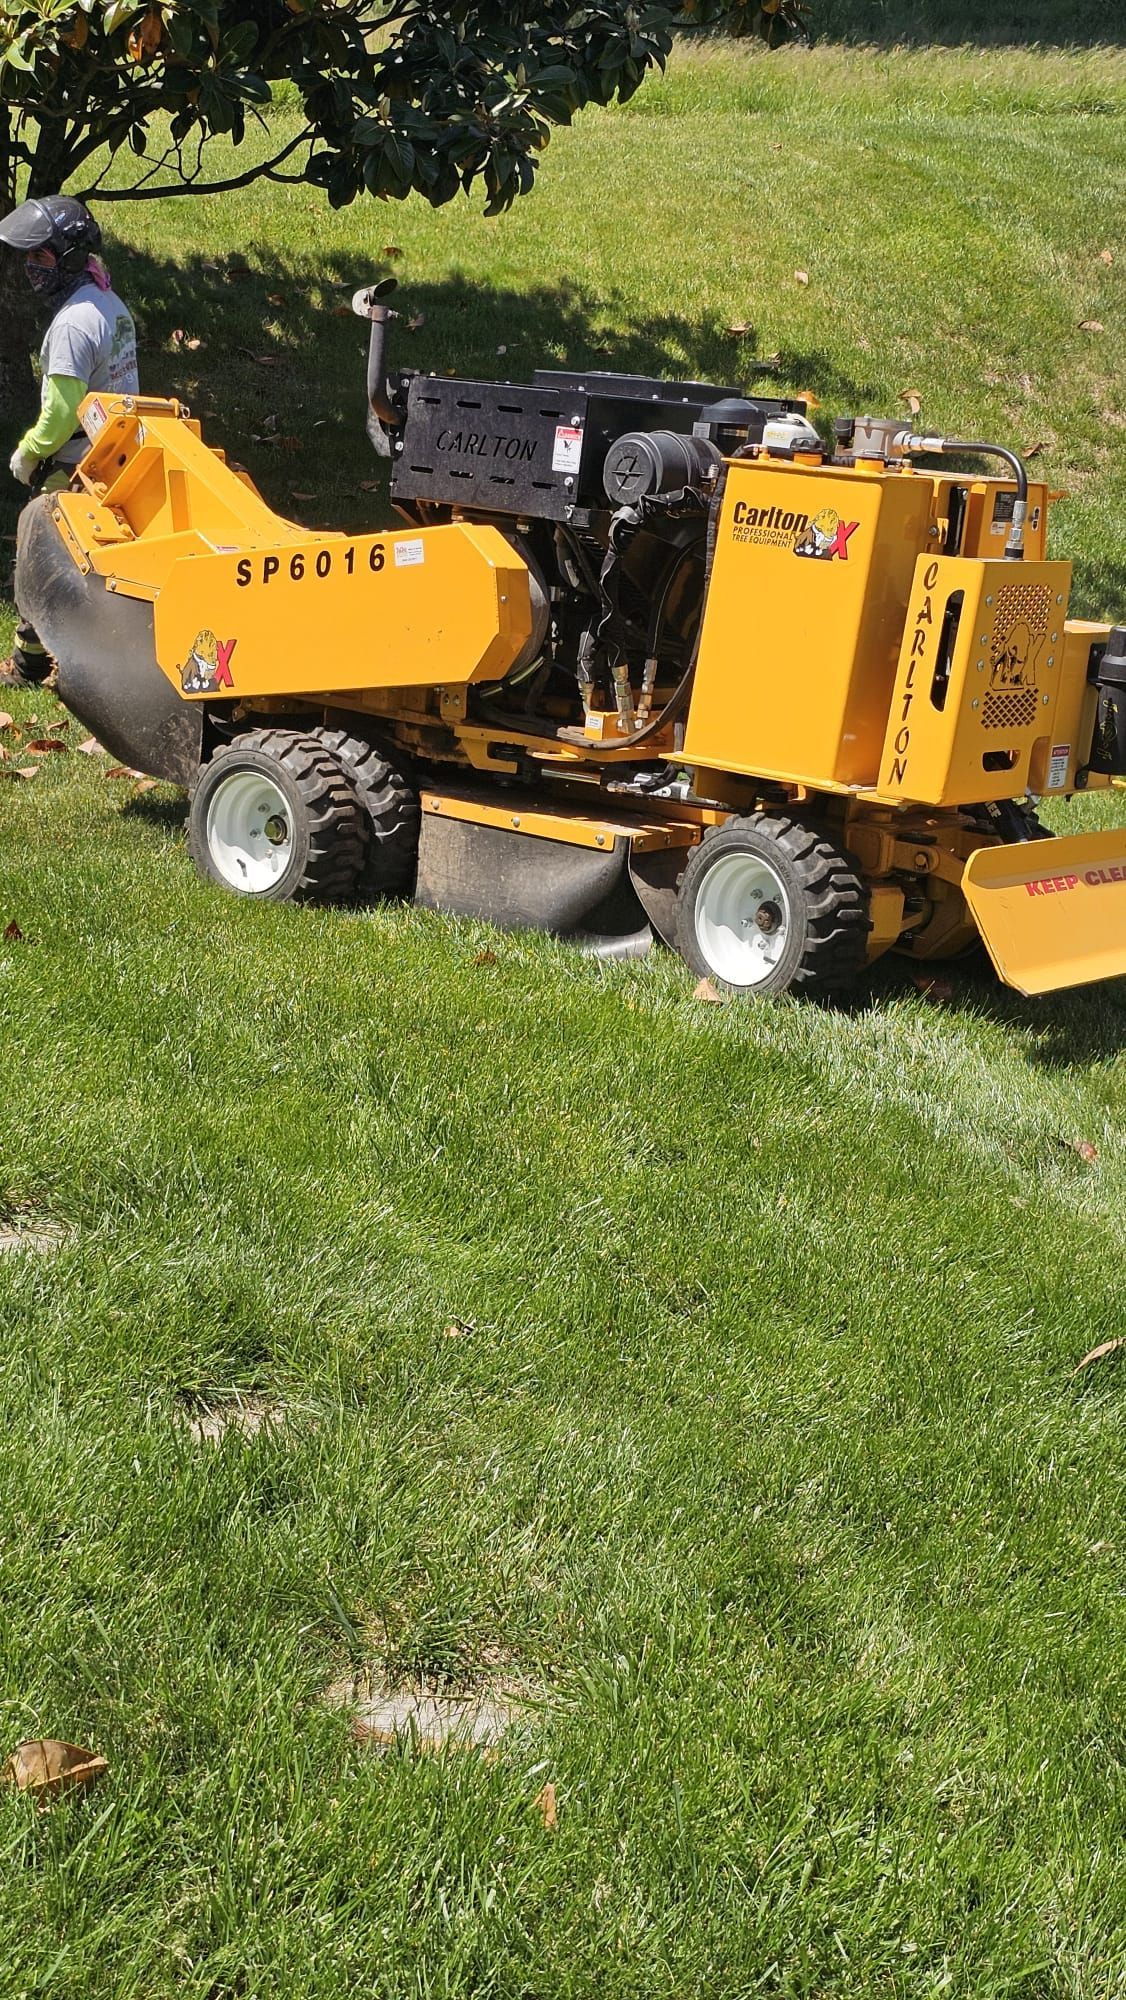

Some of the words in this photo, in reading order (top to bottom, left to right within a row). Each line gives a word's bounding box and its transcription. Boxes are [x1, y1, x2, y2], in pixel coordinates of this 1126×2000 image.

[436, 430, 538, 461] CARLTON
[733, 501, 809, 533] Carlton
[732, 526, 793, 541] PROFESSIONAL
[732, 533, 748, 543] TREE
[749, 535, 792, 549] EQUIPMENT
[236, 543, 386, 587] SP6016
[887, 561, 939, 786] CARLTON
[1024, 874, 1079, 897] KEEP
